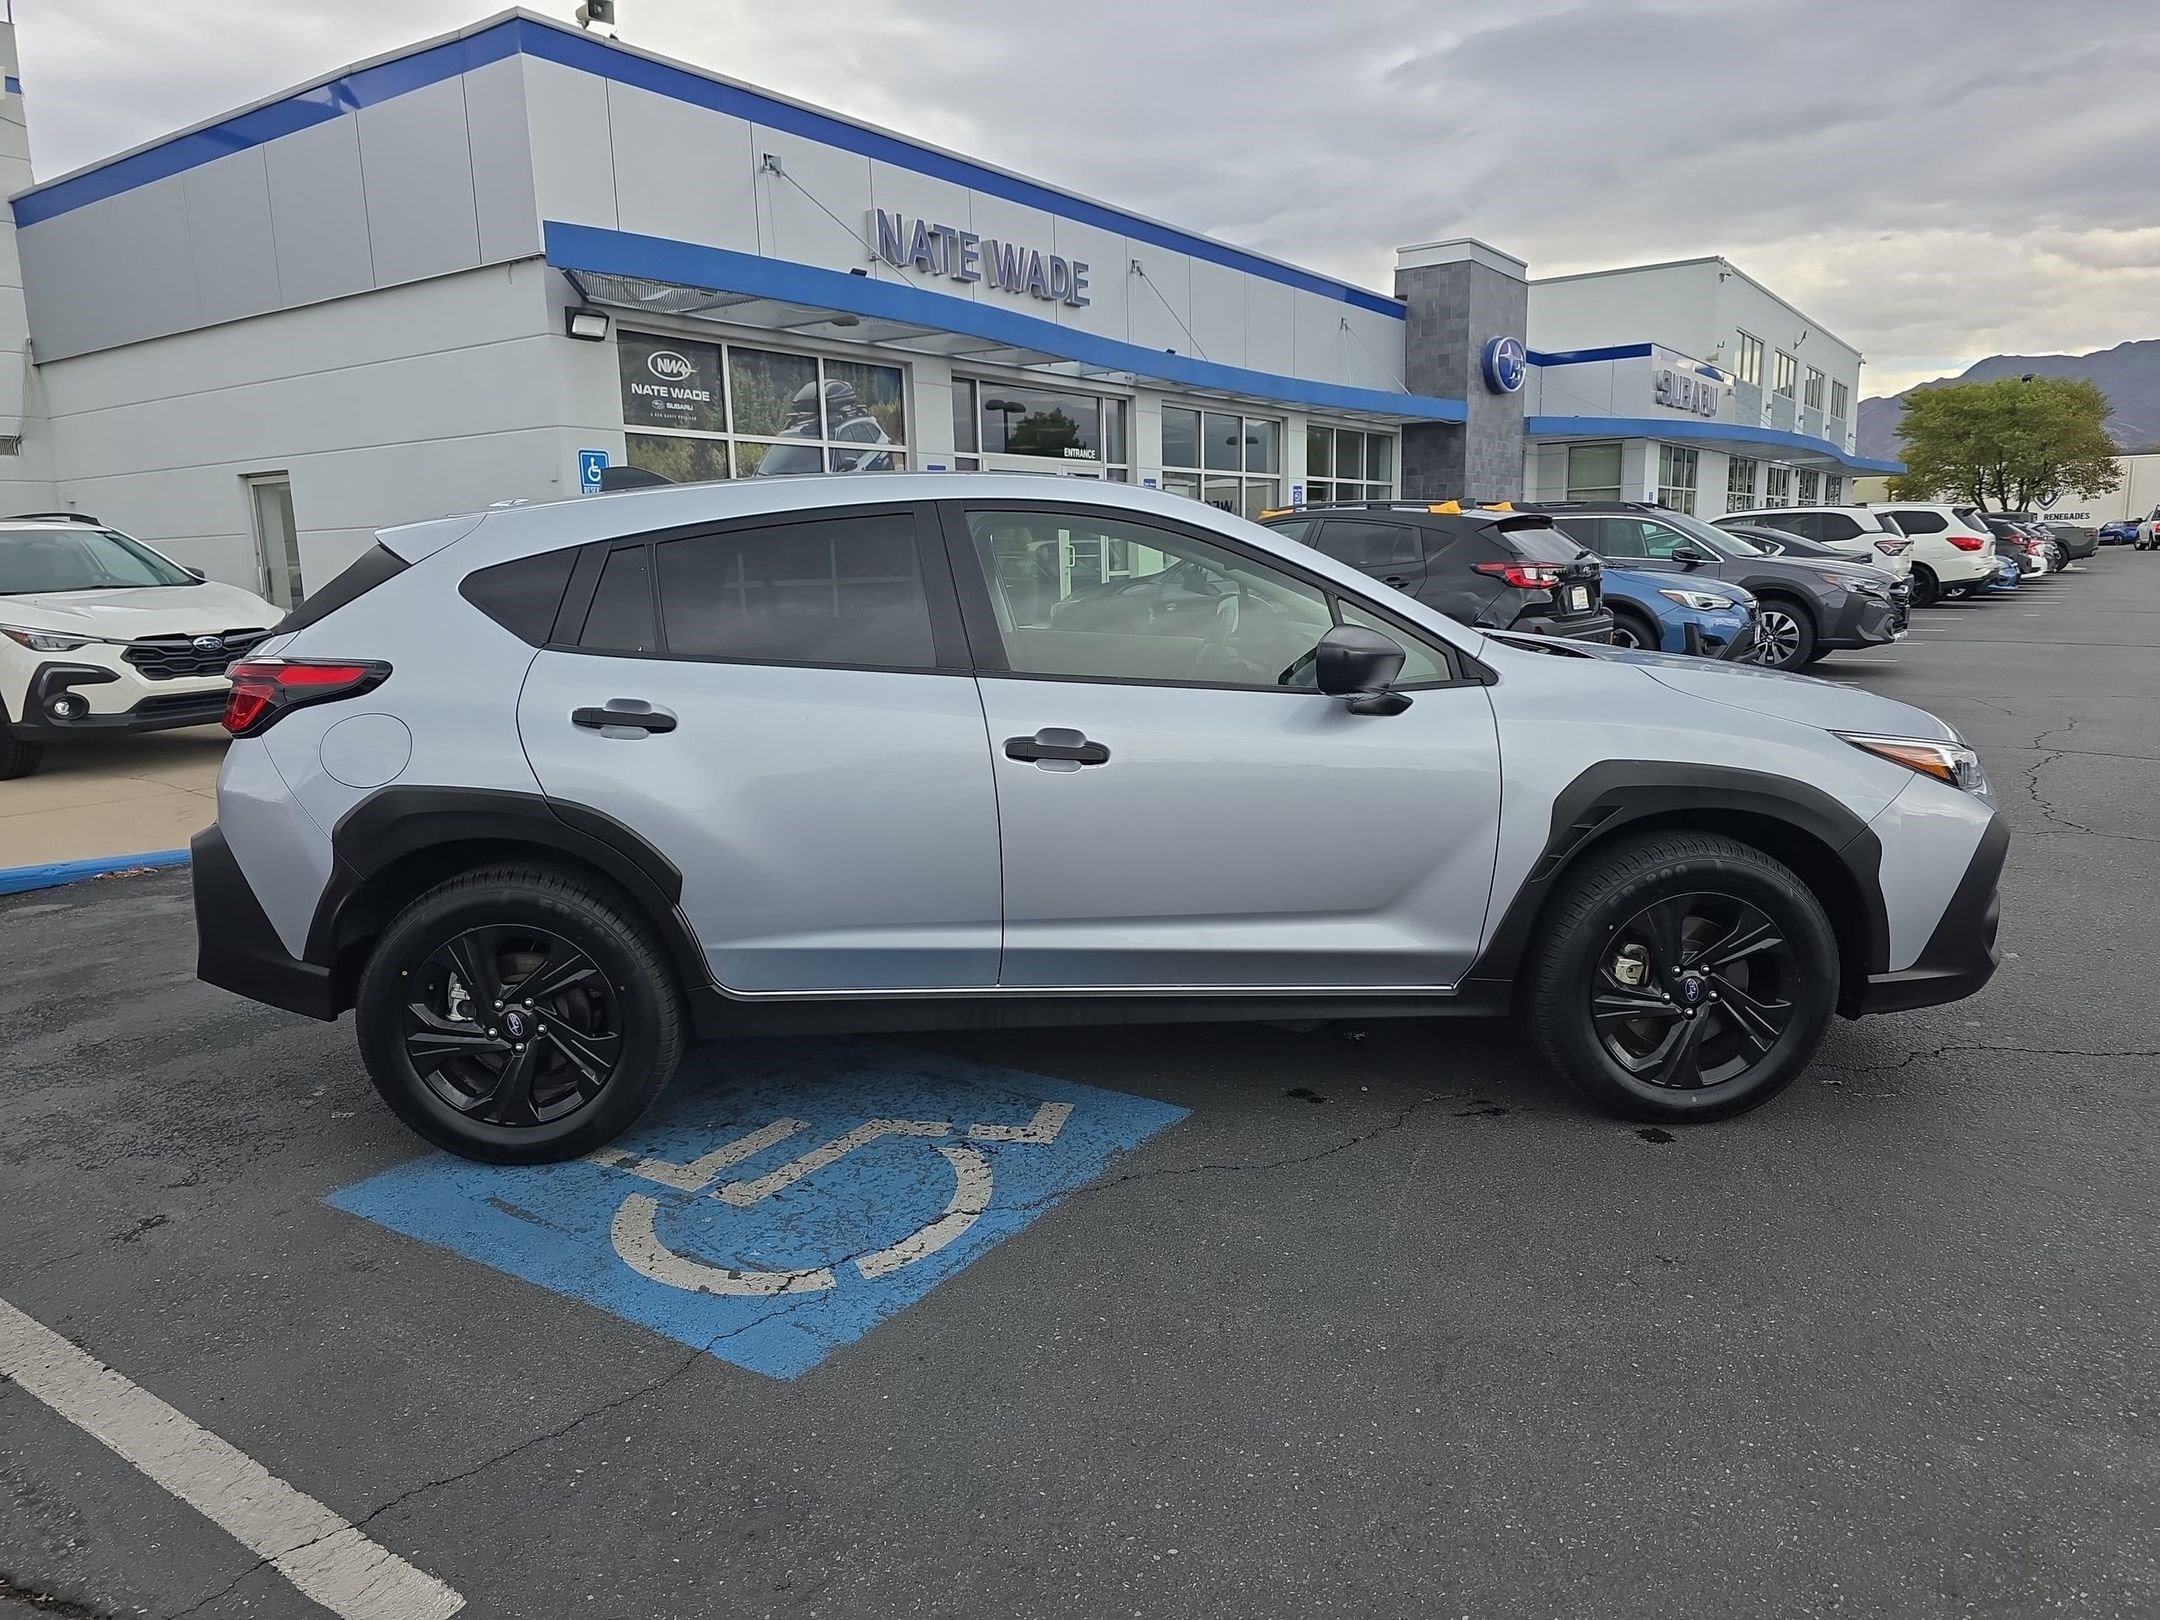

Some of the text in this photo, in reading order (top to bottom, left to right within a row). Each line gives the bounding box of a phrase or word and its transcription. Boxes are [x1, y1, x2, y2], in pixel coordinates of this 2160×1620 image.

[868, 208, 1091, 307] NATE WADE
[631, 383, 710, 402] NATE WADE
[1656, 368, 1719, 417] SUBARU
[666, 402, 694, 411] SUBARU
[1063, 447, 1096, 459] ENTRANCE
[2043, 512, 2091, 521] RENEGADES
